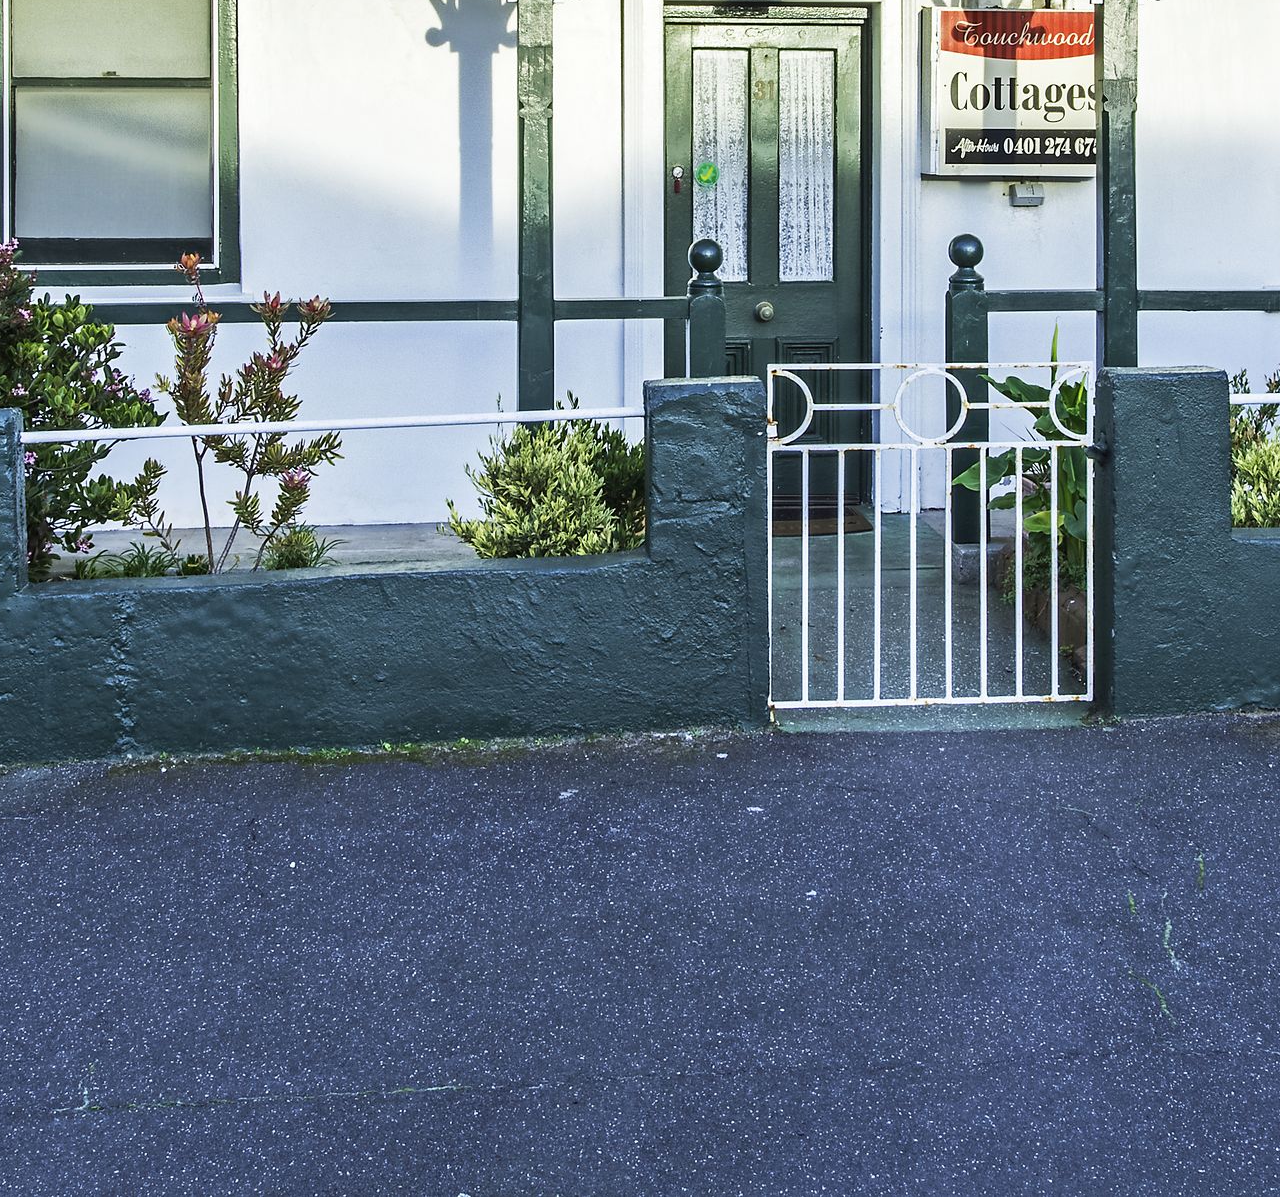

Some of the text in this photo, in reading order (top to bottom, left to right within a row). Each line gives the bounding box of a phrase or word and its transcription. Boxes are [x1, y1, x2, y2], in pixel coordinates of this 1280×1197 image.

[955, 20, 1095, 47] Touchwood
[753, 79, 775, 100] 31
[1003, 137, 1042, 155] 0401
[1044, 137, 1072, 158] 274
